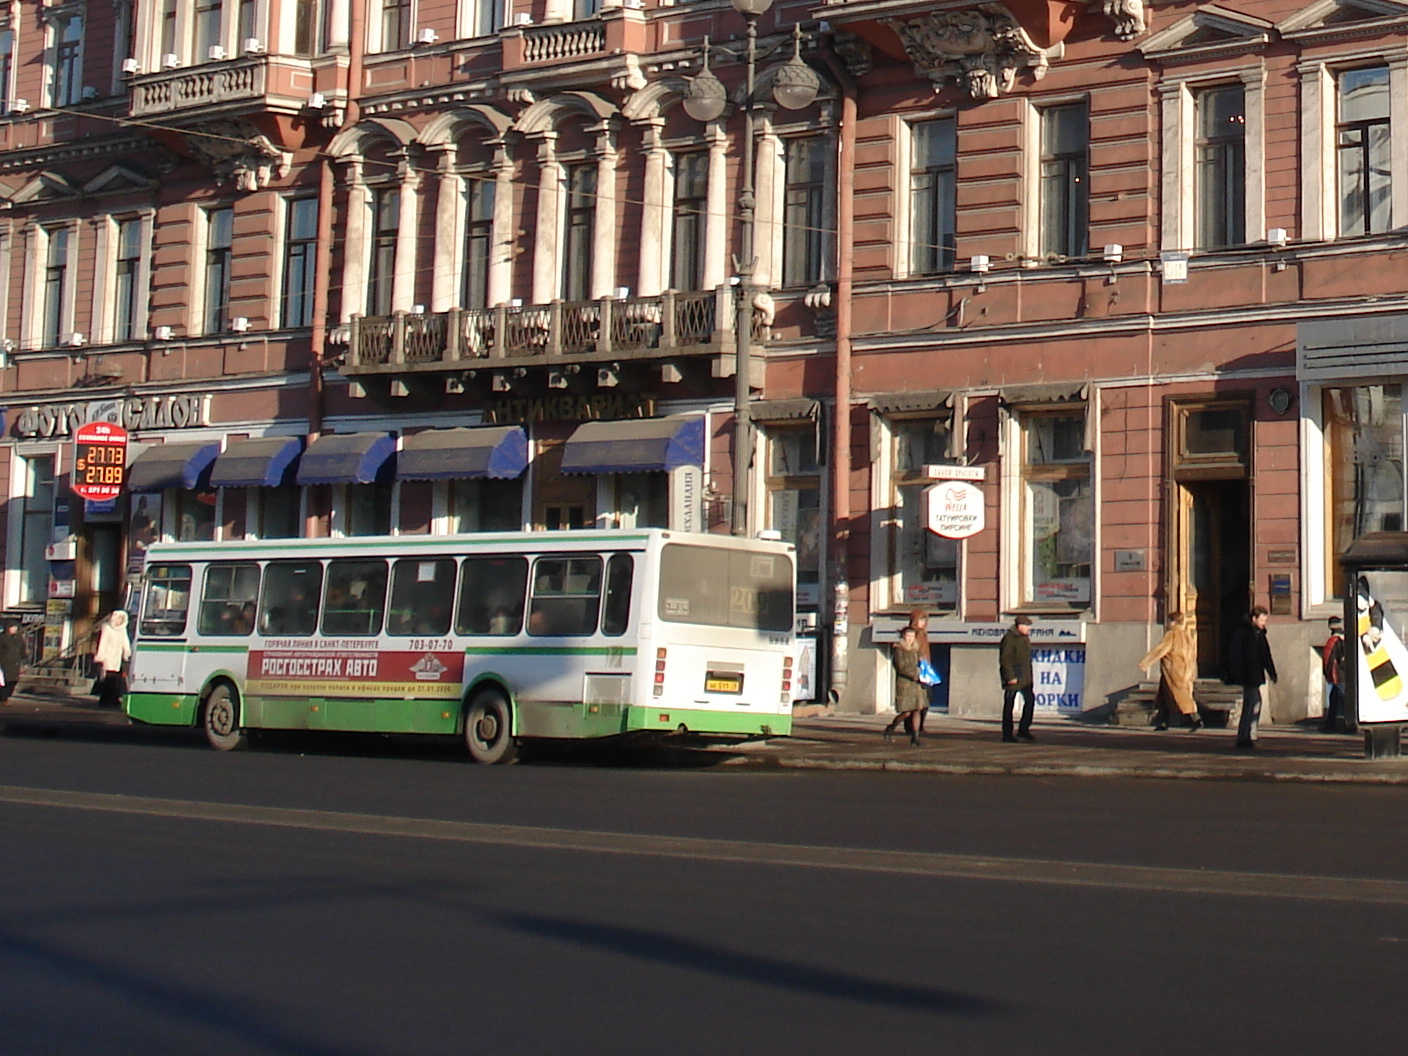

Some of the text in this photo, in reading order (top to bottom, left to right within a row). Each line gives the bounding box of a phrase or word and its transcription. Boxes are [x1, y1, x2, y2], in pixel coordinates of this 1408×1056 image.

[481, 393, 657, 423] АНТИКВАРИАТ
[18, 403, 87, 437] ФОТО
[123, 394, 213, 430] САЛОН
[945, 502, 967, 512] WELLA
[935, 514, 977, 522] ТАТУИРОВКИ
[940, 524, 973, 532] ПИРСИНГ
[264, 640, 291, 648] ГОРЯЧАЯ
[292, 640, 313, 649] ЛИНИЯ
[320, 639, 379, 649] САНКТ-ПЕТЕРБУРГЕ
[409, 639, 453, 650] 703-07-70
[1031, 649, 1085, 664] КИДКИ
[261, 658, 378, 677] РОСГОССТРАХ АВТО
[1040, 671, 1062, 685] НА
[1035, 693, 1079, 707] ОРКИ
